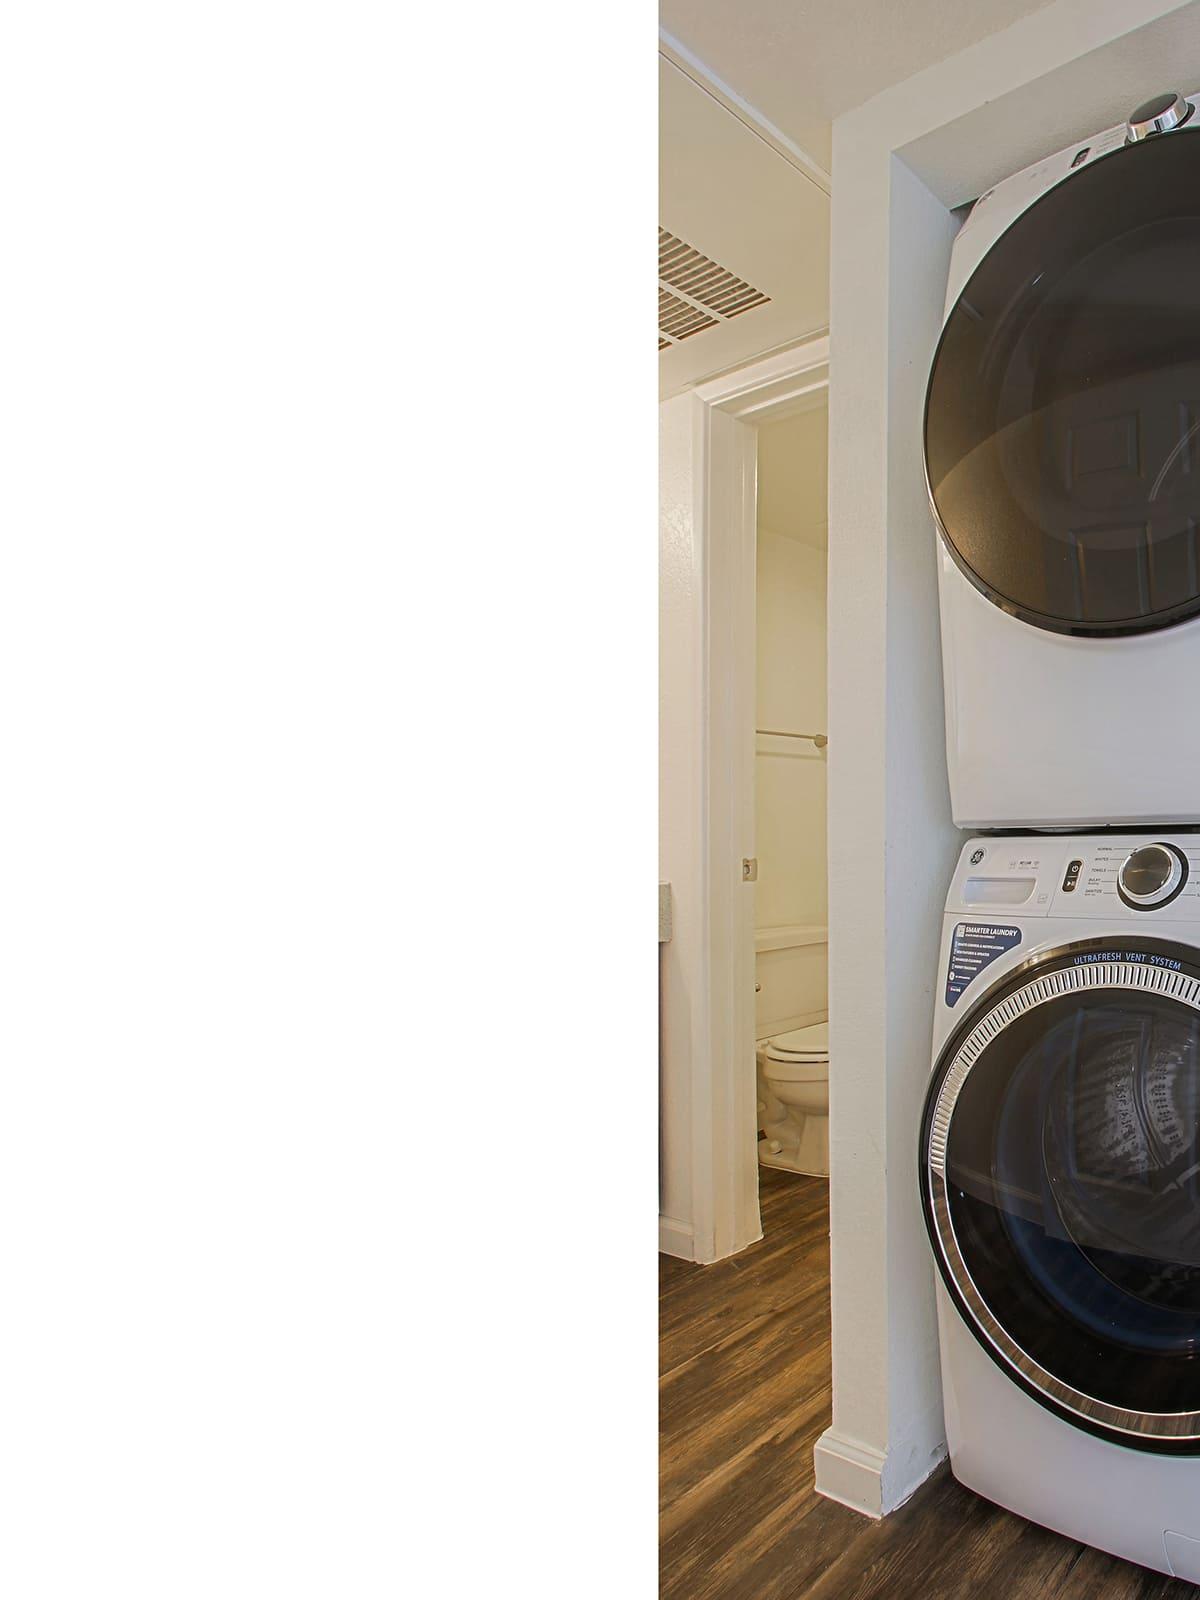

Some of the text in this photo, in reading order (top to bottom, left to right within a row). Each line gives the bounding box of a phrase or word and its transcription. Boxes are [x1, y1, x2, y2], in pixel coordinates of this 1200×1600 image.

[965, 926, 991, 935] SMARTER
[989, 928, 1018, 937] LAUNDRY
[1074, 952, 1181, 970] ULTRAFRESH VENT SYSTEM
